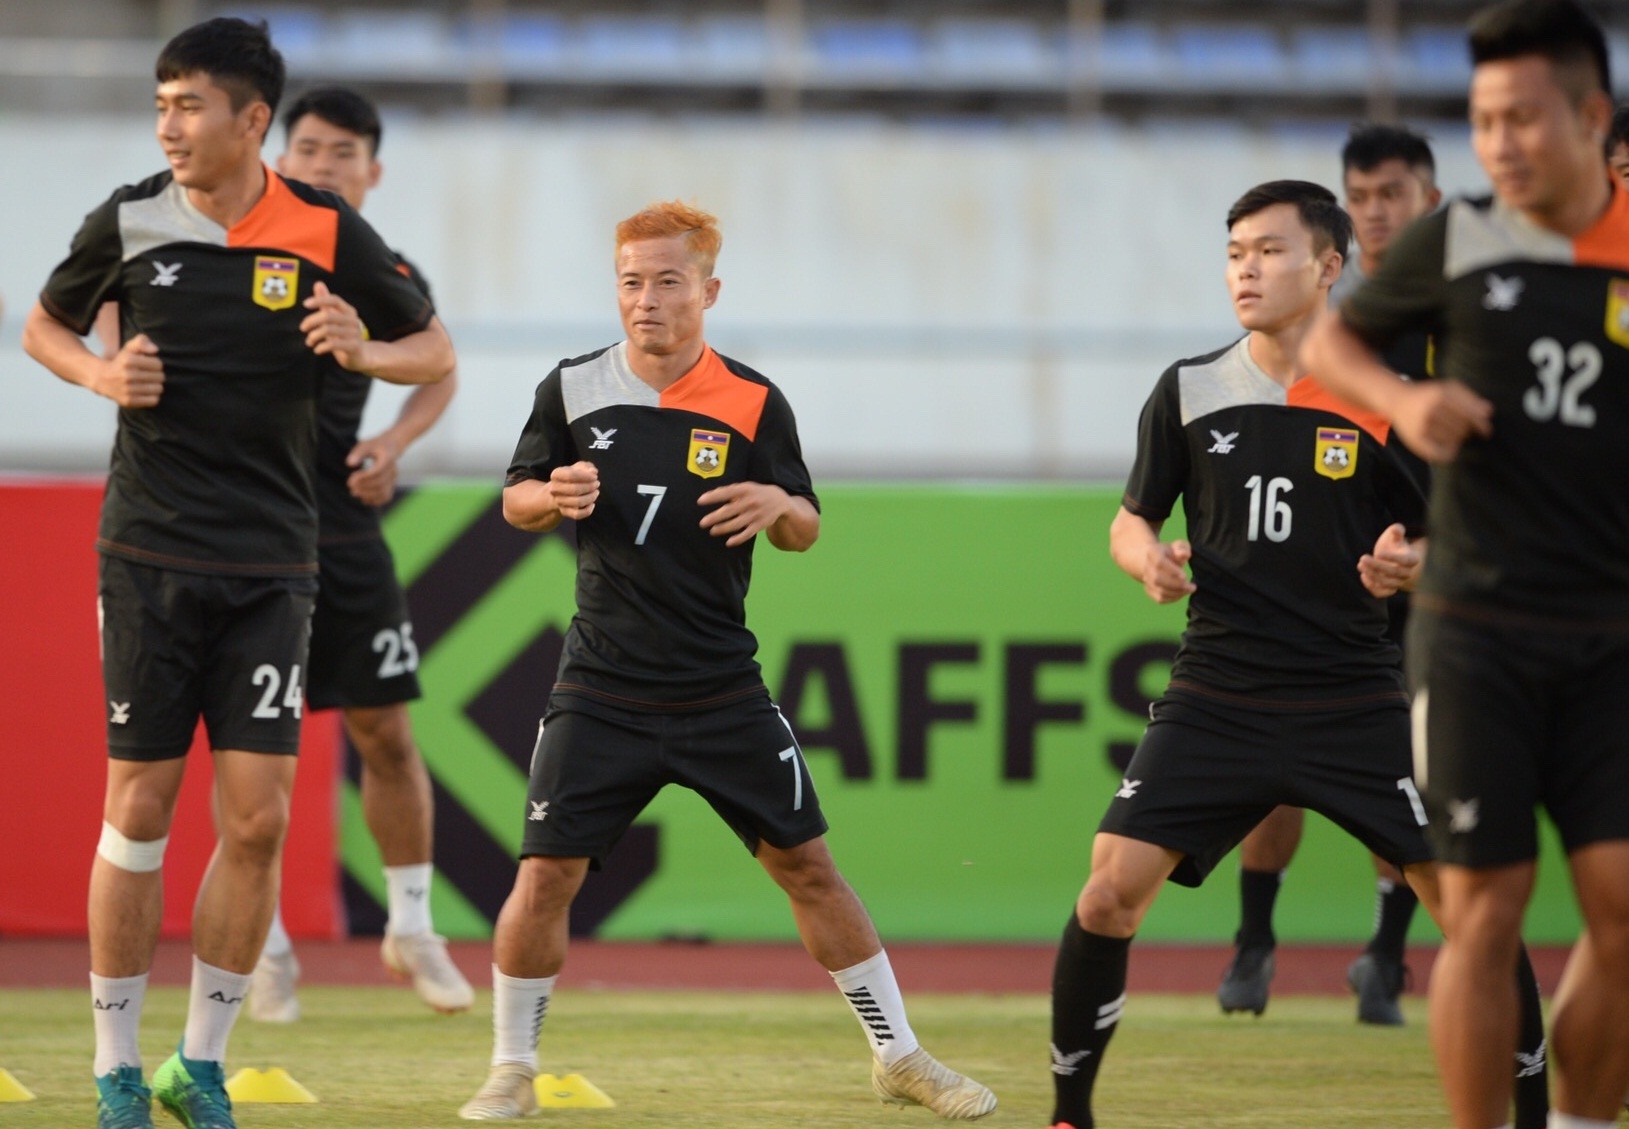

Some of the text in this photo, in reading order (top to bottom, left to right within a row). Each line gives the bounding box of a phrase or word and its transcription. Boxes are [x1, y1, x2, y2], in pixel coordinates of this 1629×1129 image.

[1522, 336, 1603, 428] 32
[634, 484, 668, 545] 7
[1244, 474, 1294, 543] 16
[251, 663, 304, 719] 24
[778, 745, 802, 811] 7
